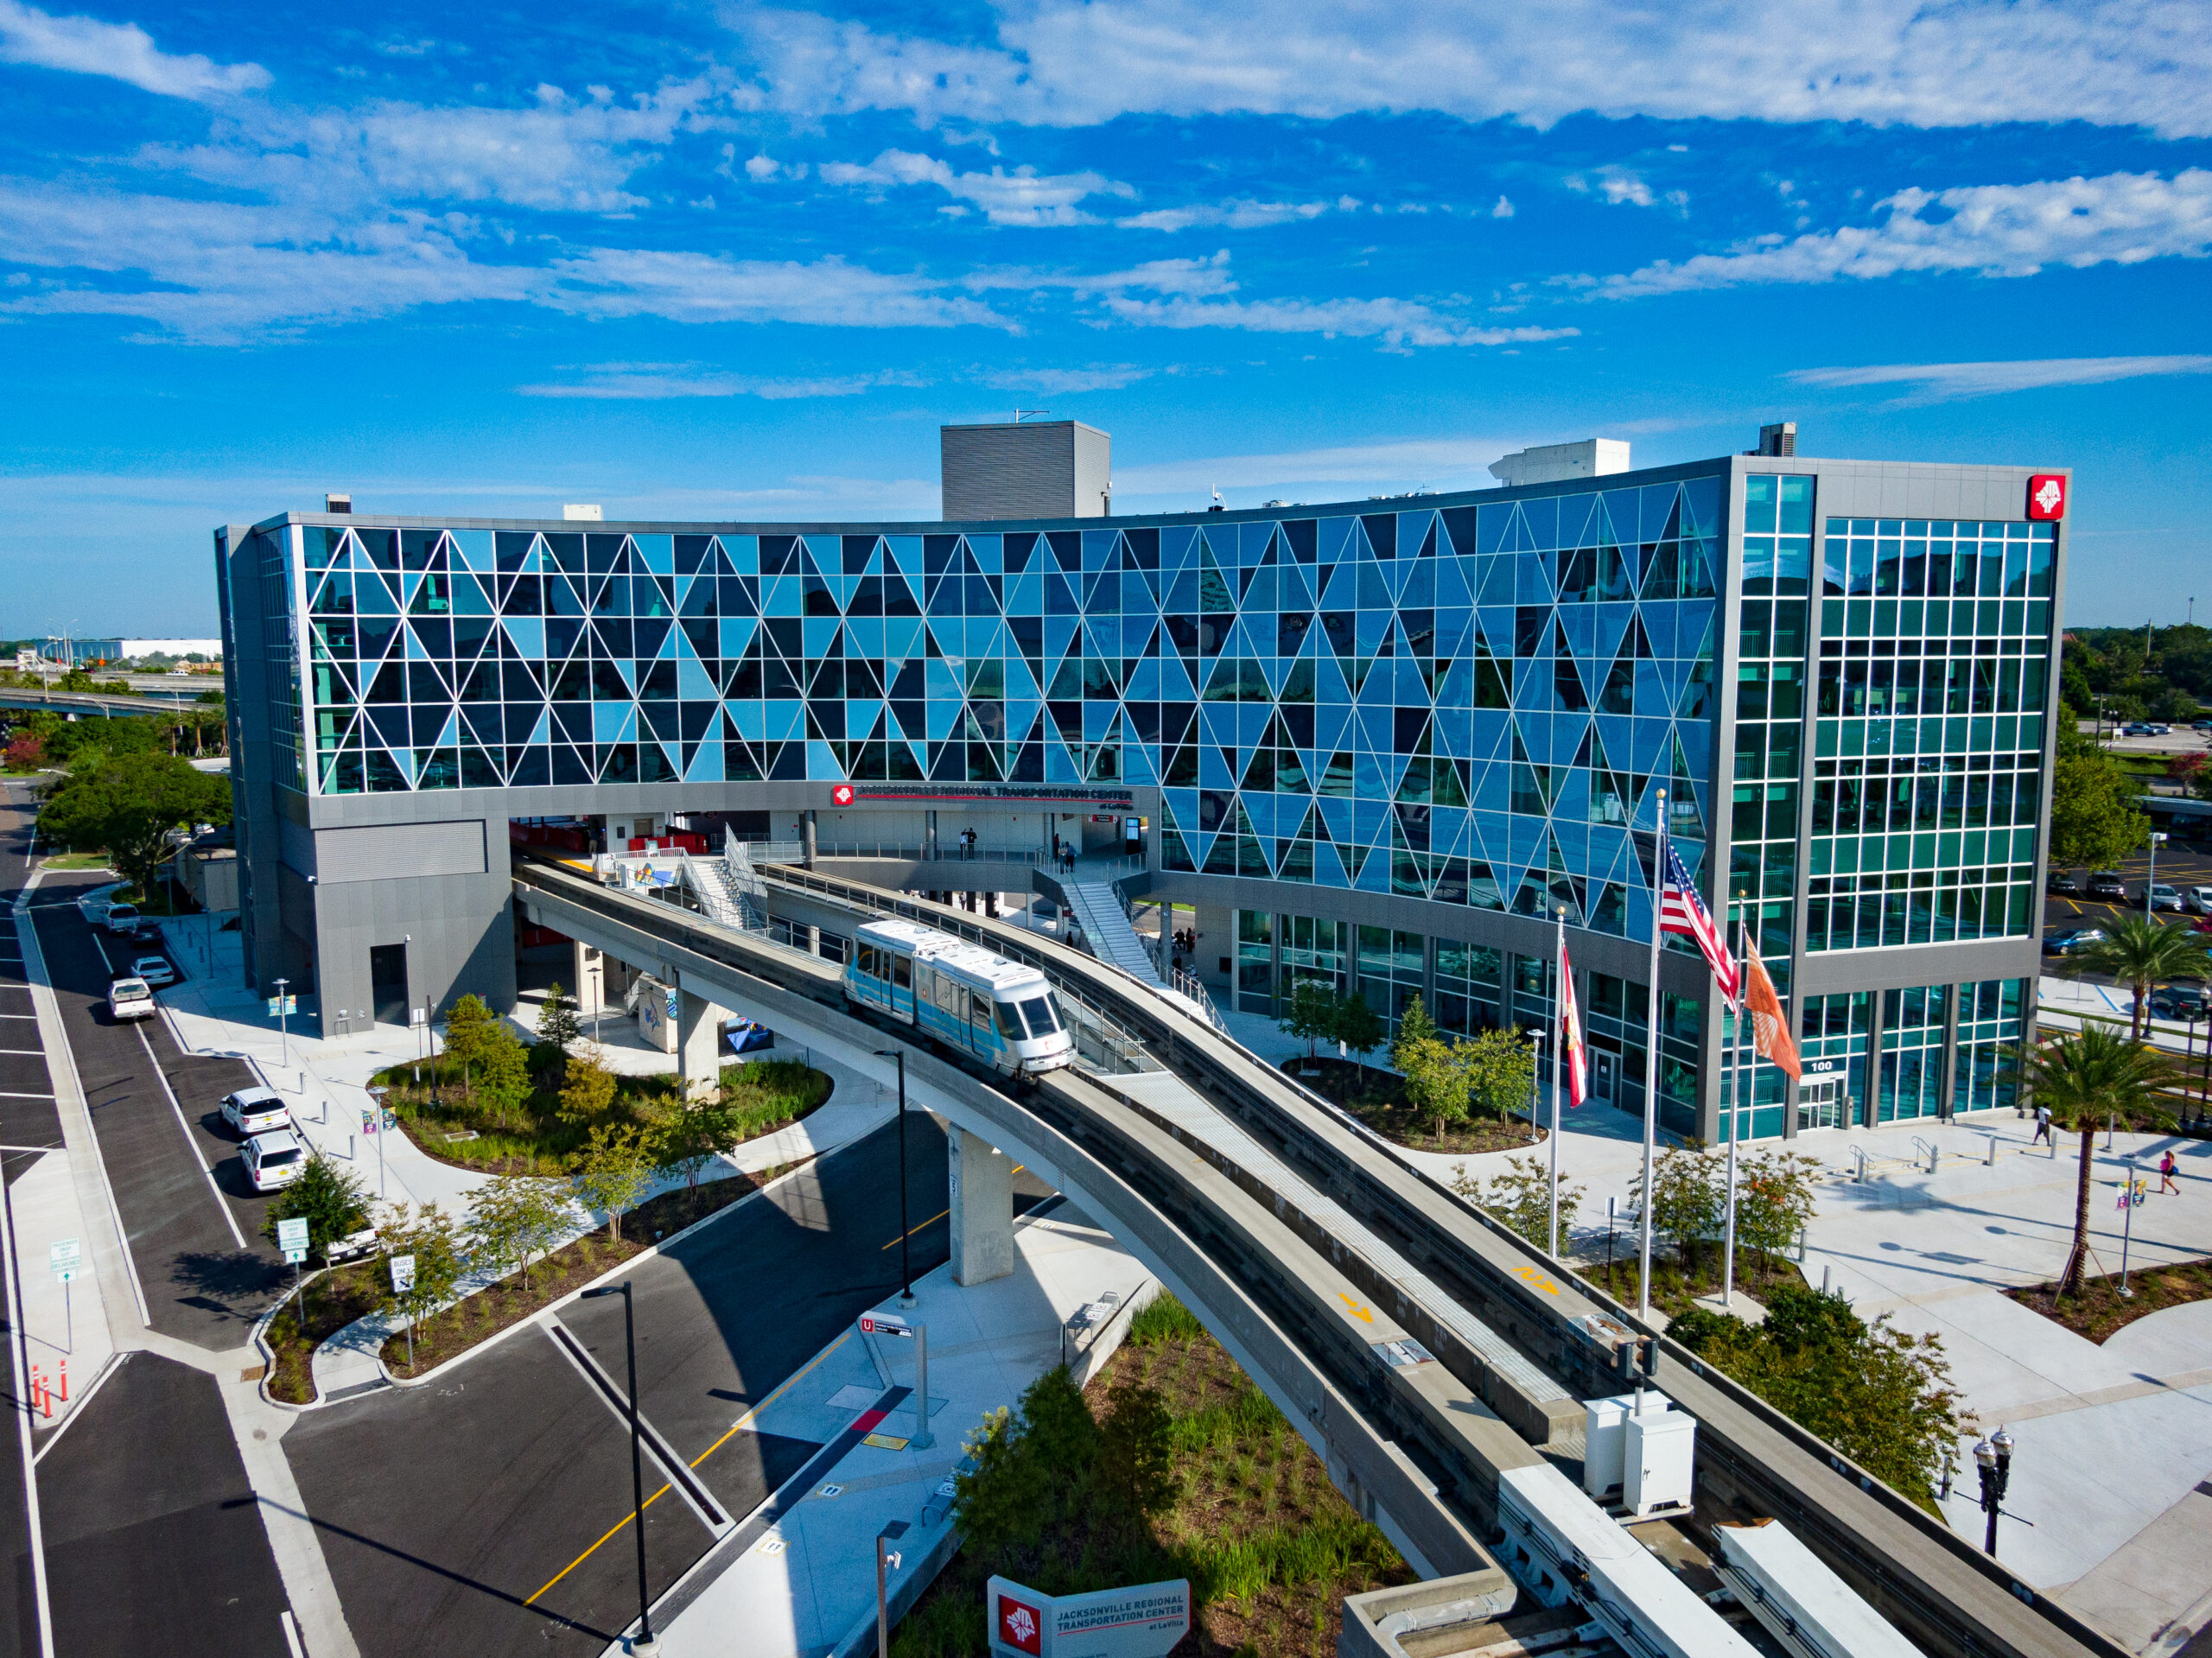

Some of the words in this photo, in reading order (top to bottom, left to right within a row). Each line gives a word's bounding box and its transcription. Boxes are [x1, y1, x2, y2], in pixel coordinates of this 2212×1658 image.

[995, 787, 1090, 798] TRANSPORTATION
[1091, 790, 1133, 800] CENTER
[1811, 1061, 1832, 1071] 100
[864, 1320, 871, 1330] U
[1058, 1602, 1131, 1621] JACKSONVILLE
[1135, 1595, 1184, 1609] REGIONAL
[1058, 1610, 1143, 1631] TRANSPORTATION
[1146, 1604, 1184, 1618] CENTER
[1158, 1620, 1184, 1629] LaVilla
